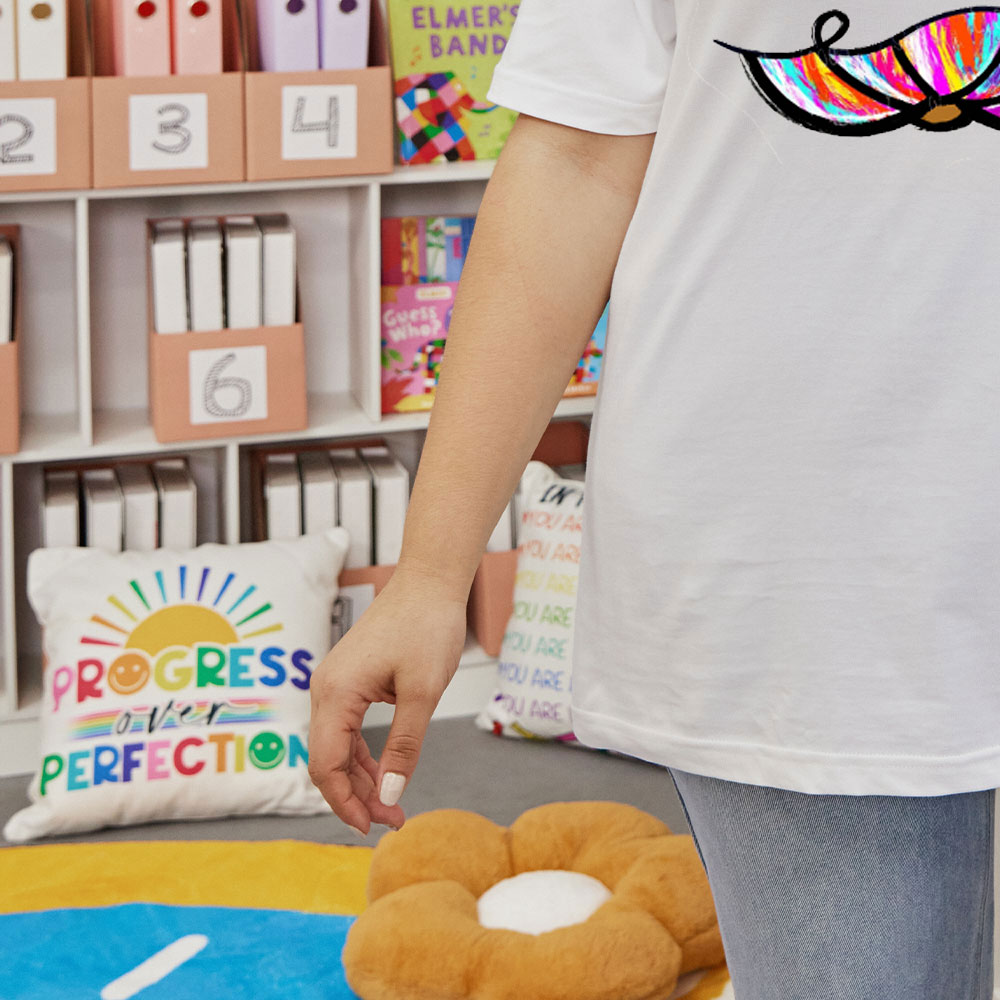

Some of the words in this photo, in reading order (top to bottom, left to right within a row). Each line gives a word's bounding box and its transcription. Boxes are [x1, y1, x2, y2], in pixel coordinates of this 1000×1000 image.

[430, 34, 508, 58] BAND
[152, 103, 192, 155] 3
[291, 96, 338, 147] 4
[0, 113, 34, 163] 2
[383, 306, 437, 327] Guess
[387, 321, 441, 342] Who?
[204, 352, 252, 418] 6
[540, 605, 572, 627] ARE
[535, 636, 567, 660] ARE
[52, 647, 314, 712] PROGRESS
[532, 667, 564, 692] ARE
[116, 700, 228, 735] over
[530, 699, 562, 721] ARE
[40, 732, 309, 796] PERFECTION
